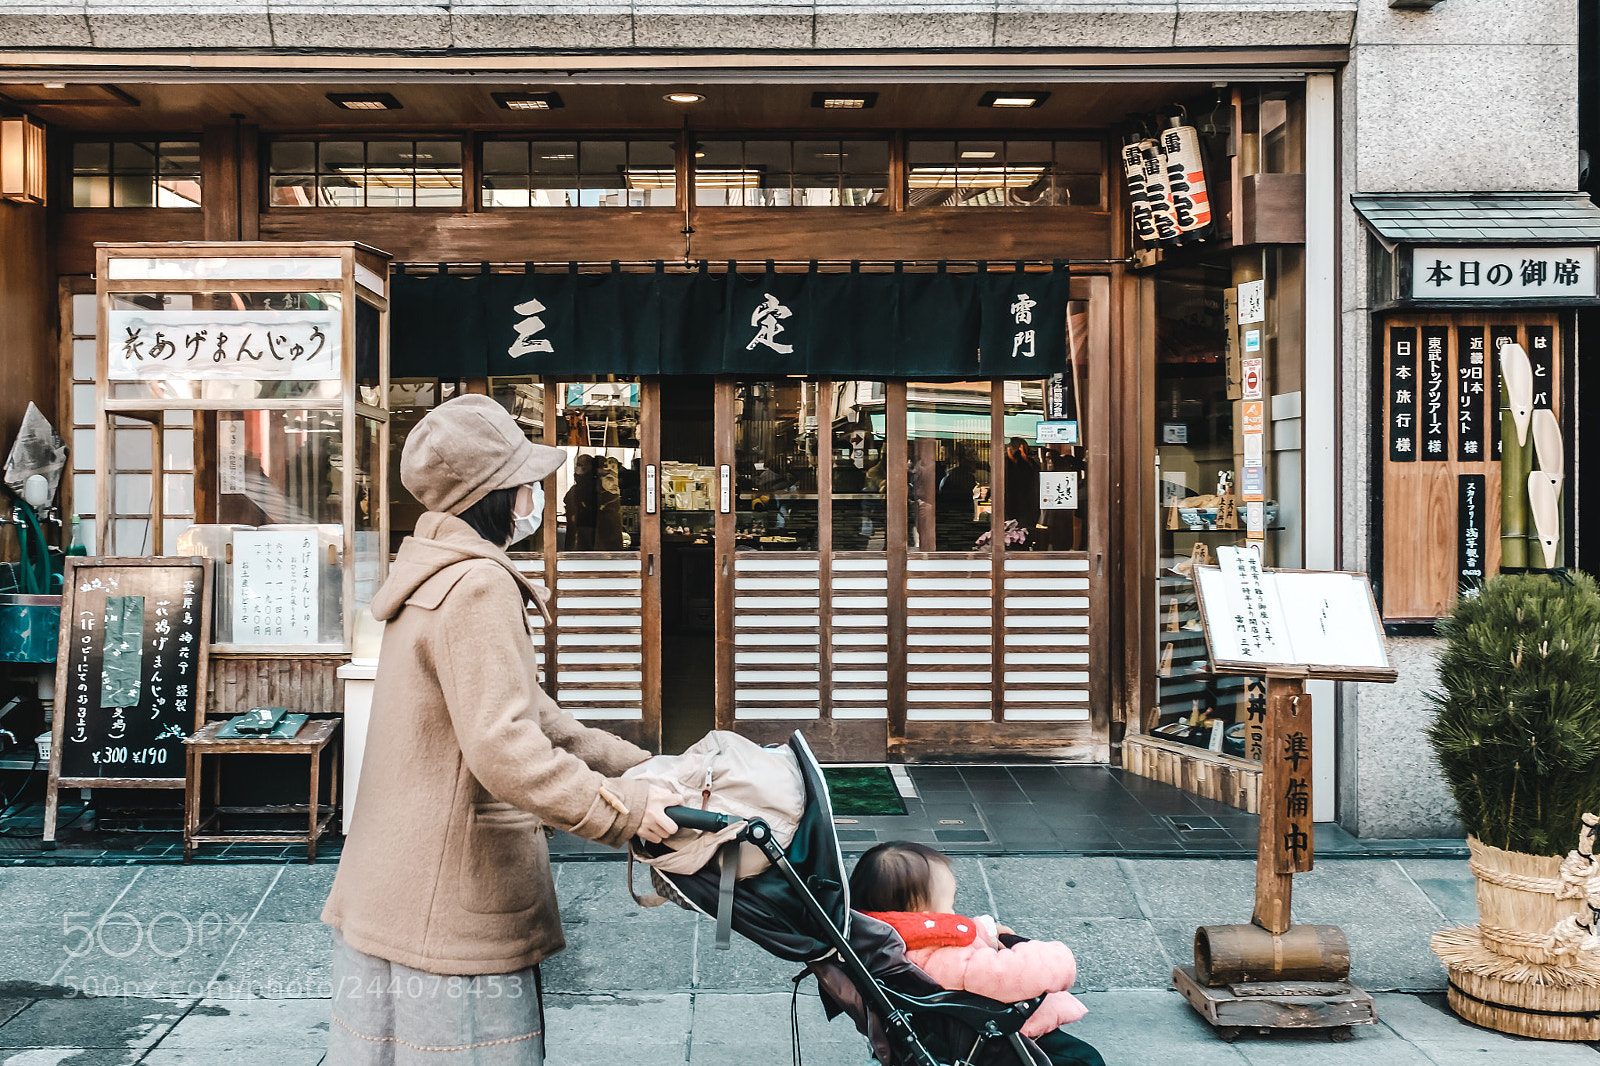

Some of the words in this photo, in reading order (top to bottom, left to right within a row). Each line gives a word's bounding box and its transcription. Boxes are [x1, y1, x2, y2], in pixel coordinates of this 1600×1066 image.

[1425, 258, 1581, 287] 本日の御席
[122, 326, 326, 363] 花あげまんじゅう
[1010, 293, 1037, 358] 雷門
[1395, 341, 1412, 452] 日本旅行様
[1470, 337, 1484, 394] 近畿日本
[1533, 336, 1548, 405] はとバ
[1459, 367, 1471, 434] ツーリスト
[302, 536, 311, 638] あげまんじゅう
[1234, 615, 1246, 633] 雷門
[1240, 638, 1253, 656] 三定
[1284, 731, 1309, 861] 準備中
